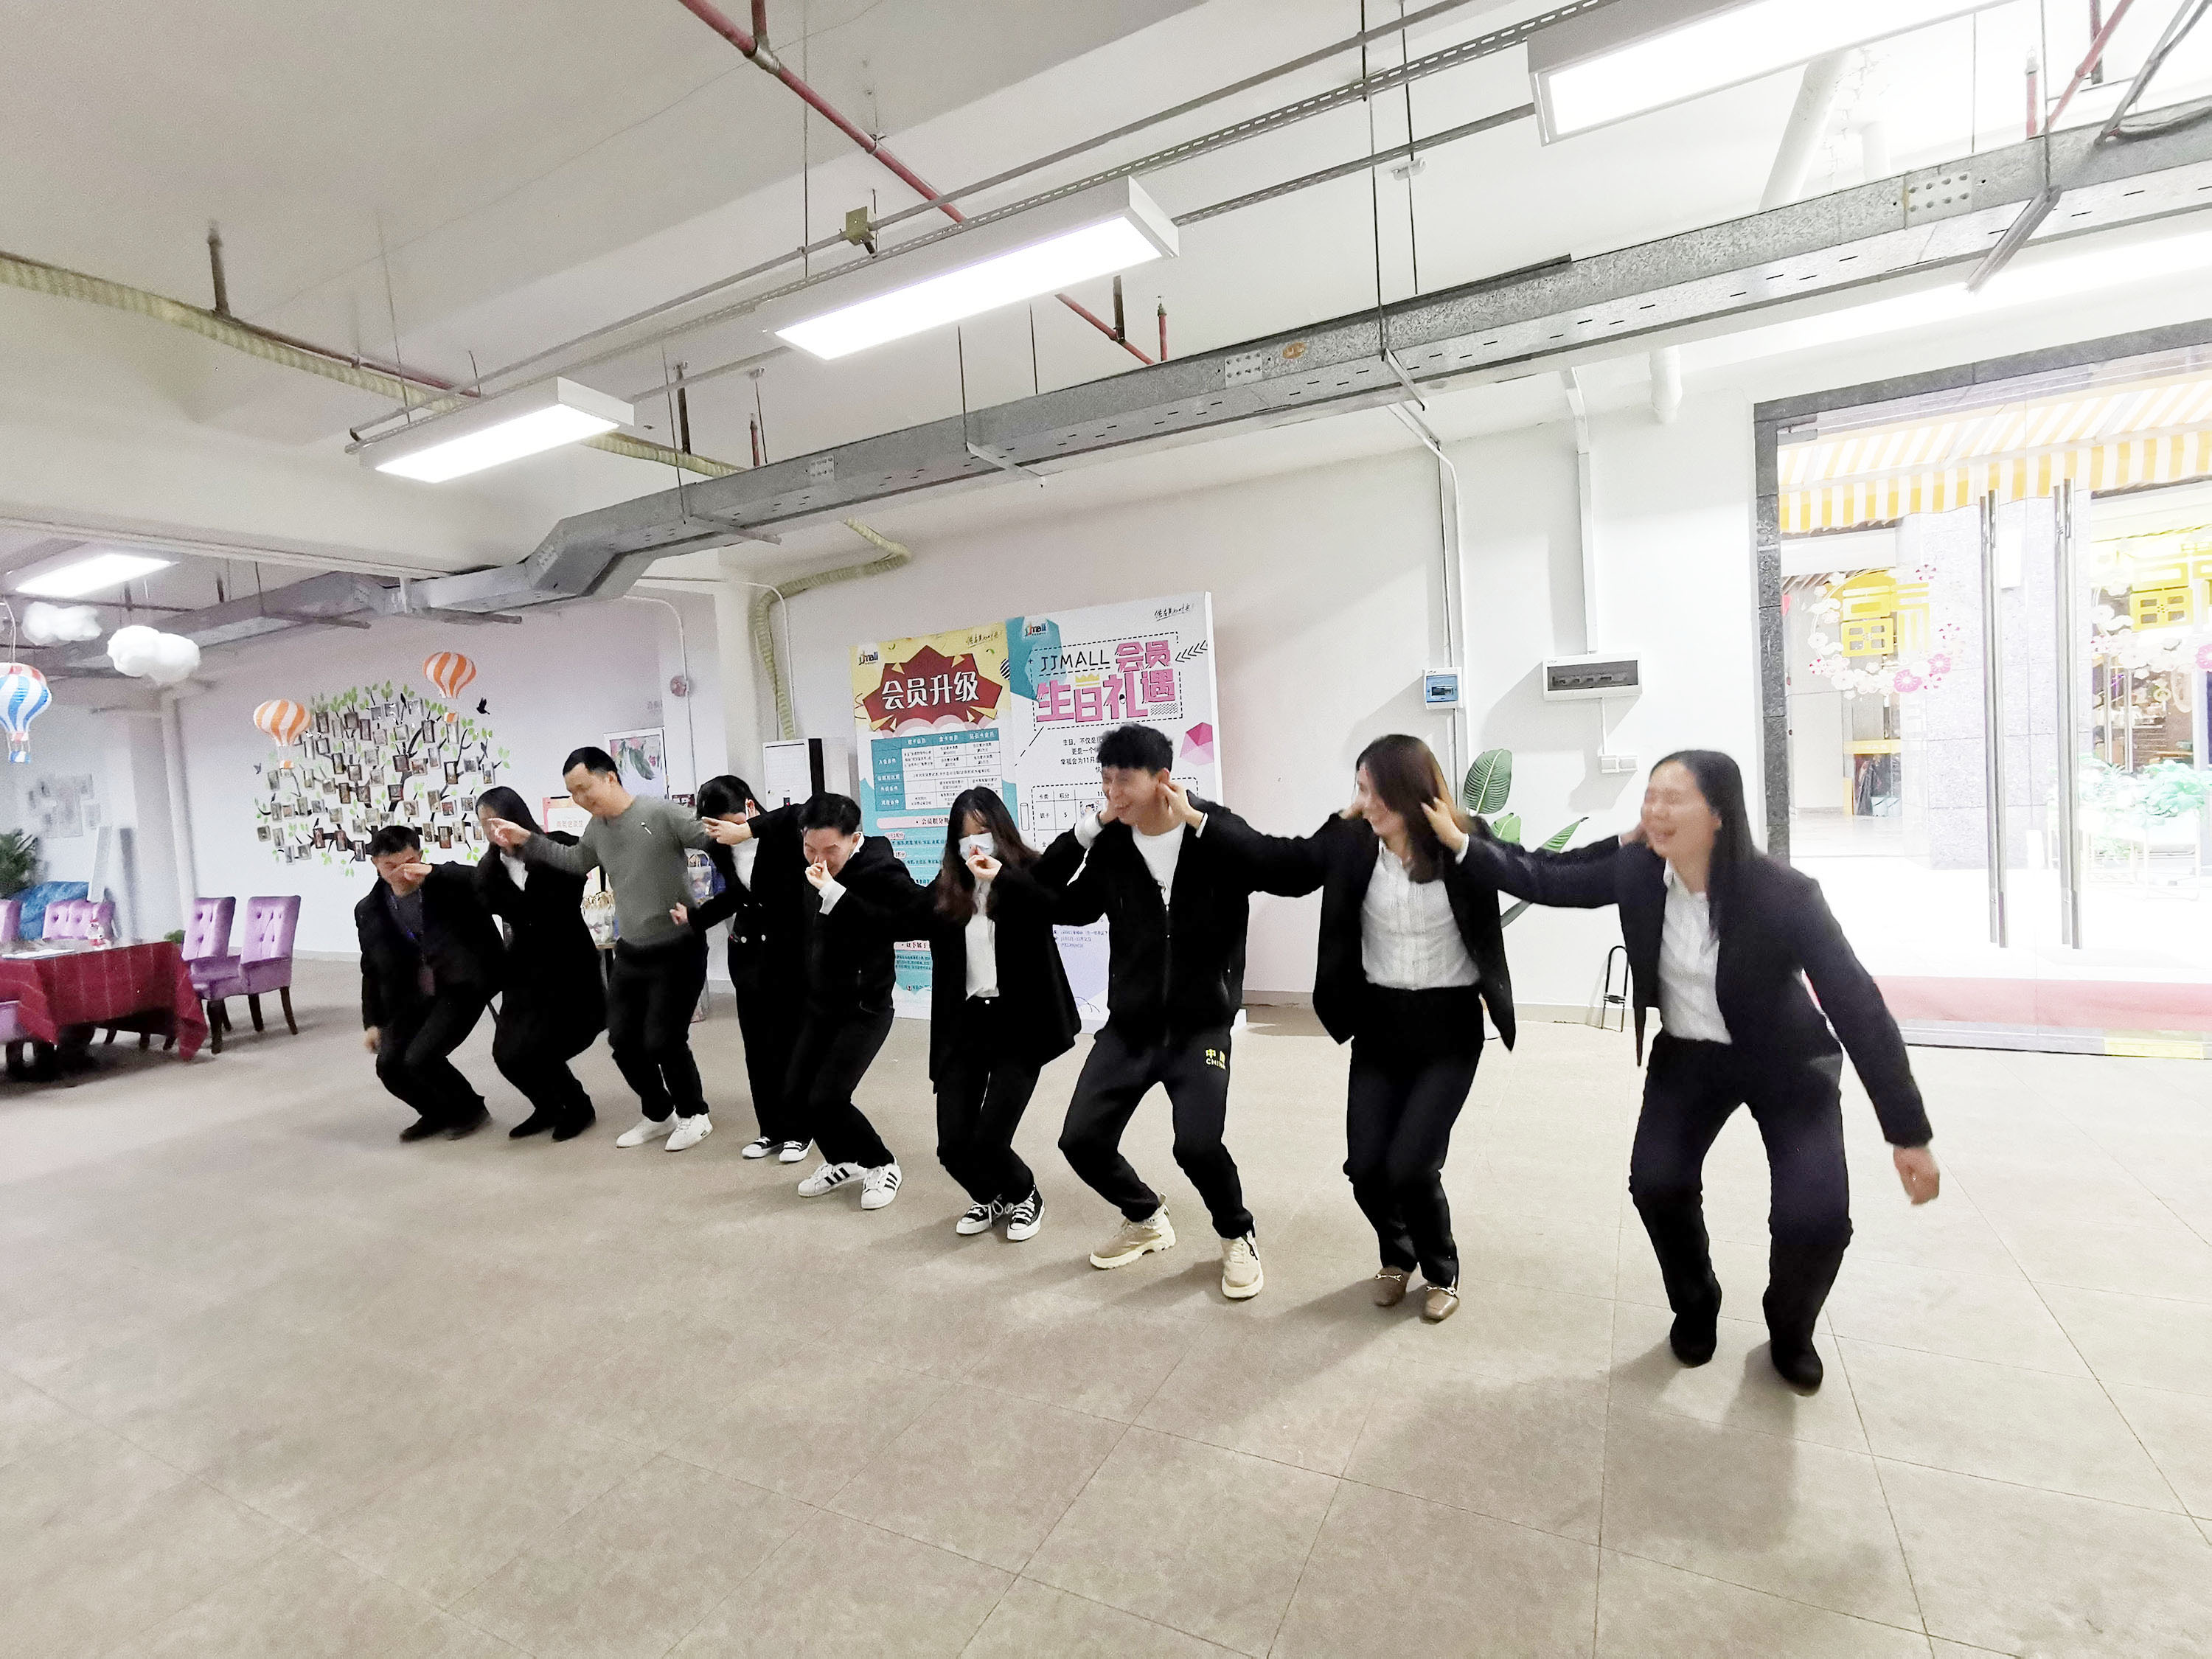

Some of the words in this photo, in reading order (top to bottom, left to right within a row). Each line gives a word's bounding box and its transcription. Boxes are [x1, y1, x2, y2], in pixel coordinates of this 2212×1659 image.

[1040, 649, 1110, 672] JJMALL
[1115, 639, 1172, 672] 会员
[881, 671, 980, 710] 会员升级
[1036, 668, 1176, 723] 生日礼遇
